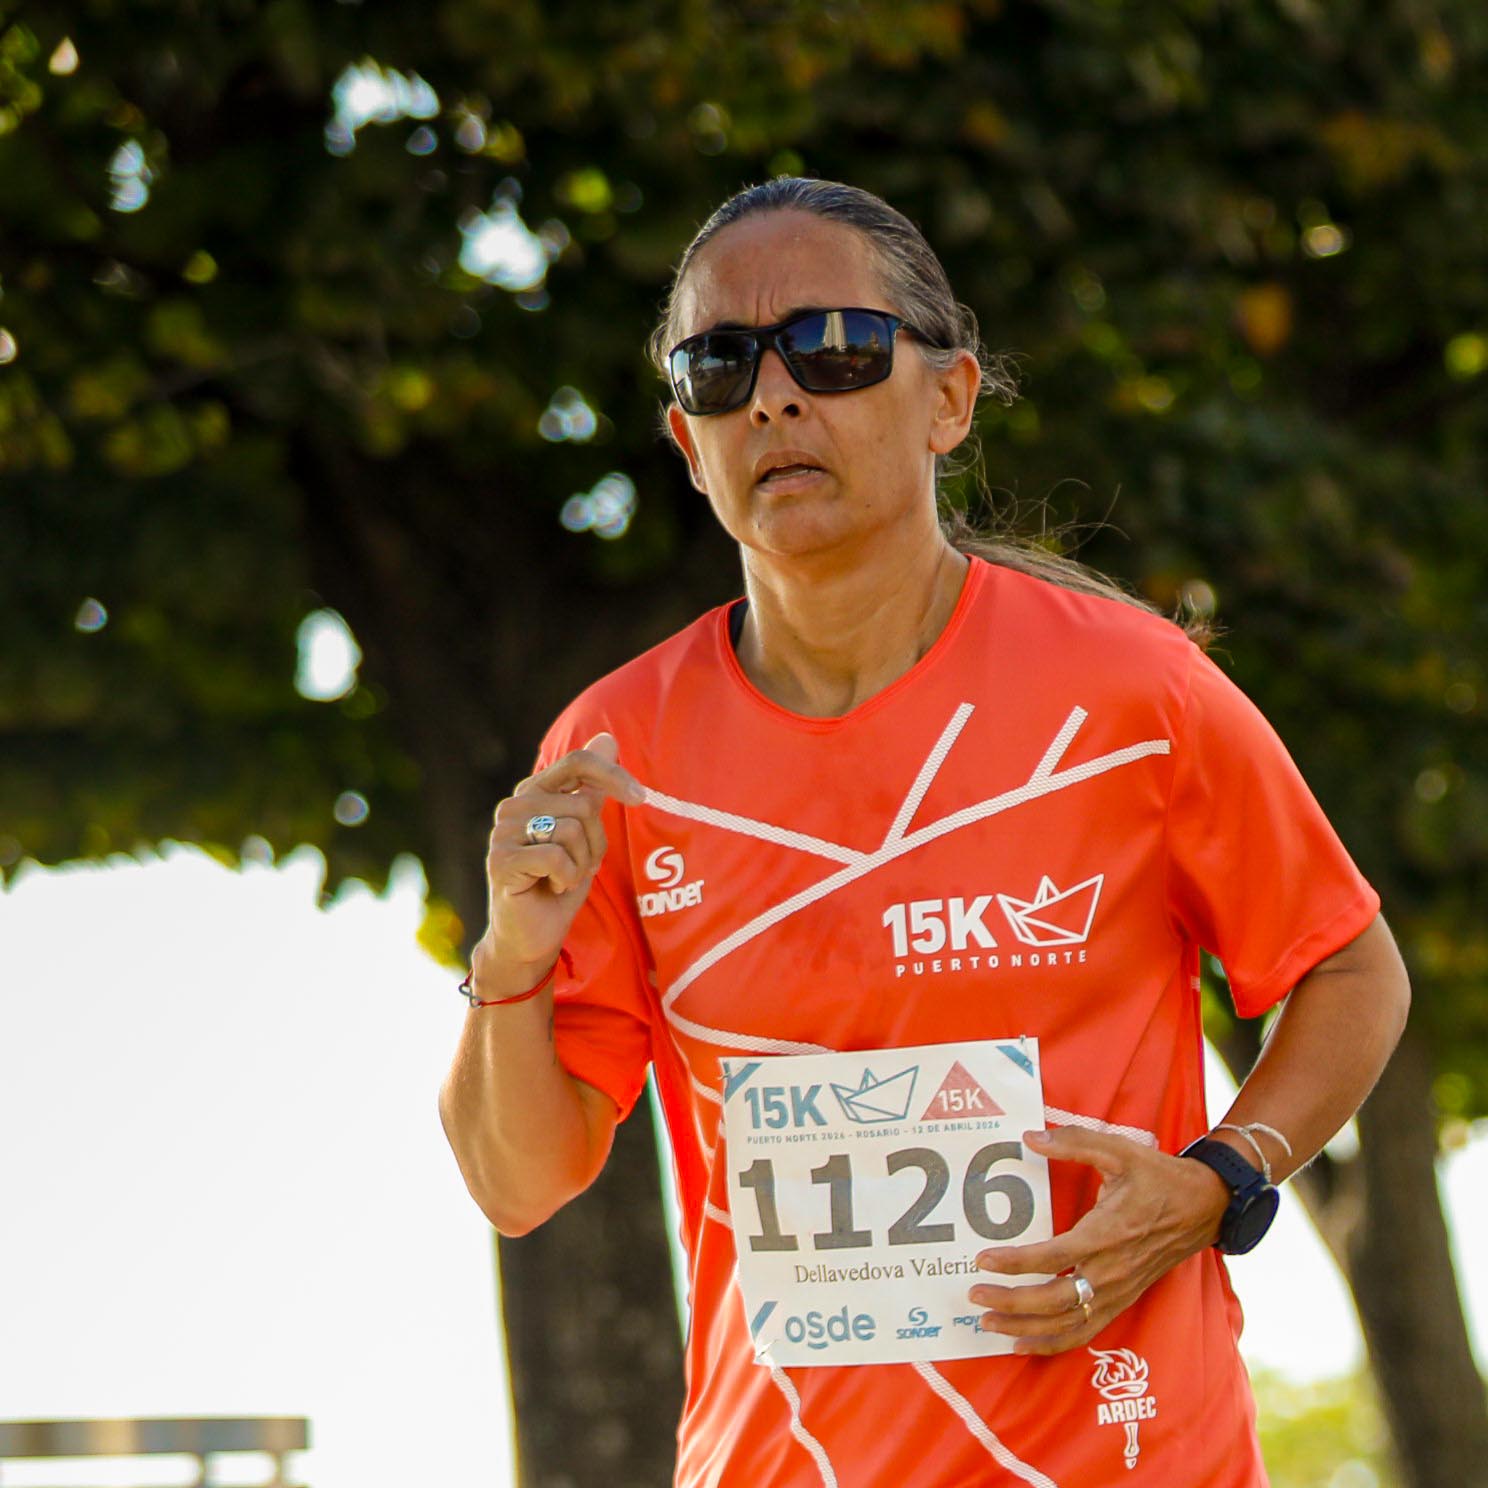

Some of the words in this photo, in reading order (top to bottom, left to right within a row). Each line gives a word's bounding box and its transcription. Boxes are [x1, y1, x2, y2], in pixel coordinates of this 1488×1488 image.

[882, 895, 998, 958] 15K
[896, 955, 999, 977] PUERTO
[1011, 950, 1086, 967] NORTE
[744, 1084, 827, 1129] 15K
[938, 1087, 984, 1112] 15K
[748, 1135, 782, 1145] PUERTO
[785, 1133, 817, 1143] NORTE
[856, 1128, 900, 1138] ROSARIO
[912, 1125, 924, 1134] 12
[928, 1125, 940, 1133] DE
[944, 1123, 973, 1132] ABRIL
[976, 1121, 1001, 1130] 2026
[739, 1141, 1035, 1252] 1126
[795, 1262, 904, 1283] Dellavedova
[910, 1255, 979, 1277] Valeria
[785, 1305, 876, 1349] osde
[1097, 1396, 1157, 1425] ARDEC
